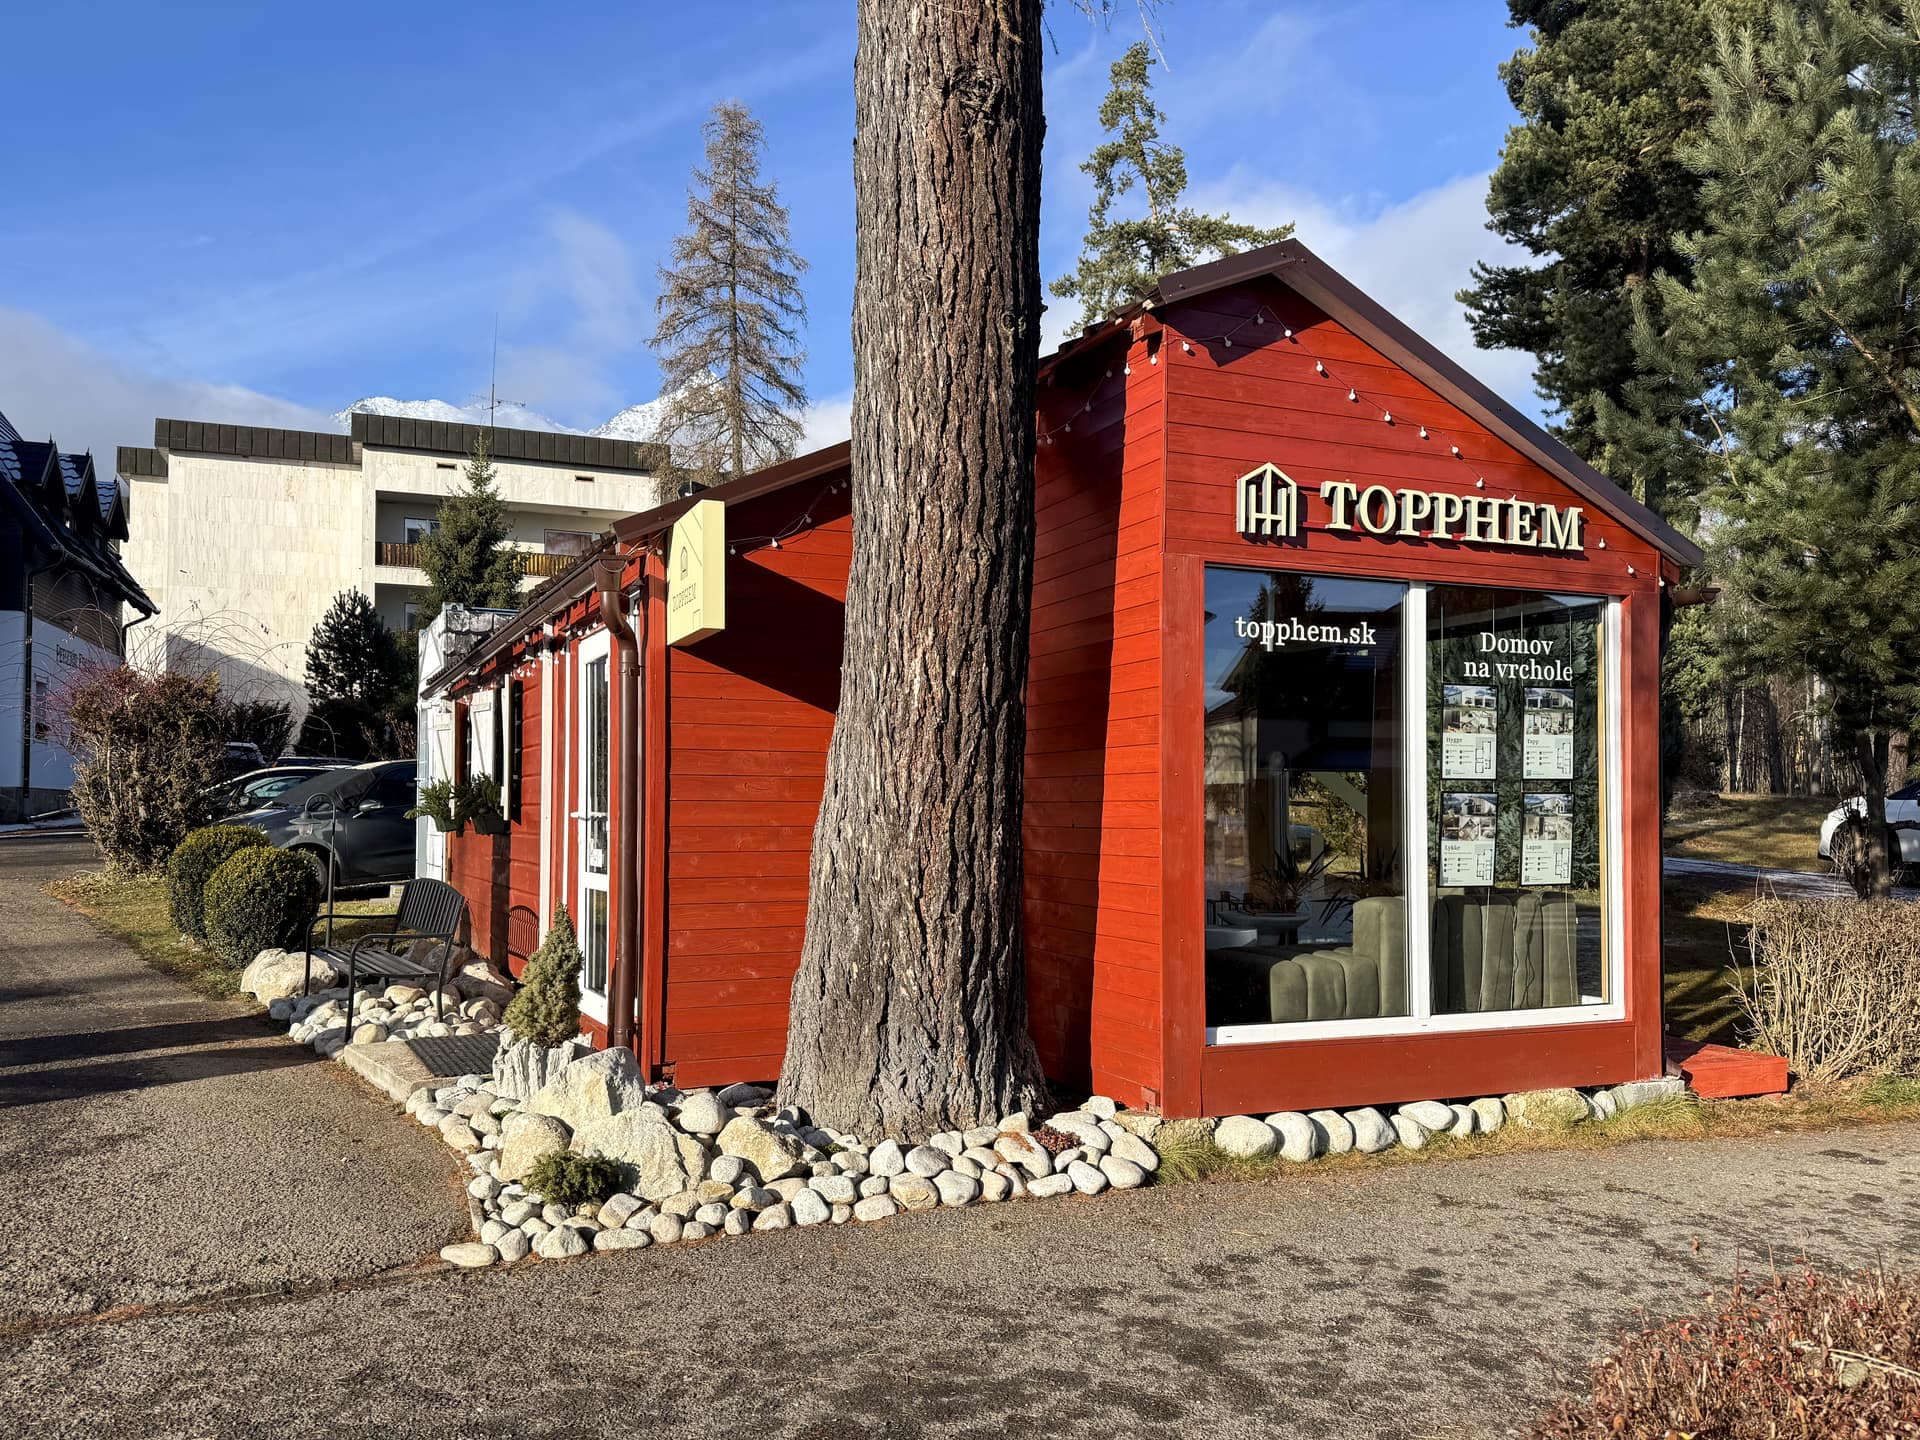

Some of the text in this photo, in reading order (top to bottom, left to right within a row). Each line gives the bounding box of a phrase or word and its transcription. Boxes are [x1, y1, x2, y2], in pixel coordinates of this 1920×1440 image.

[1320, 479, 1584, 552] TOPPHEM
[1234, 616, 1377, 647] topphem.sk
[1480, 632, 1554, 655] Domov
[1464, 658, 1574, 681] na vrchole
